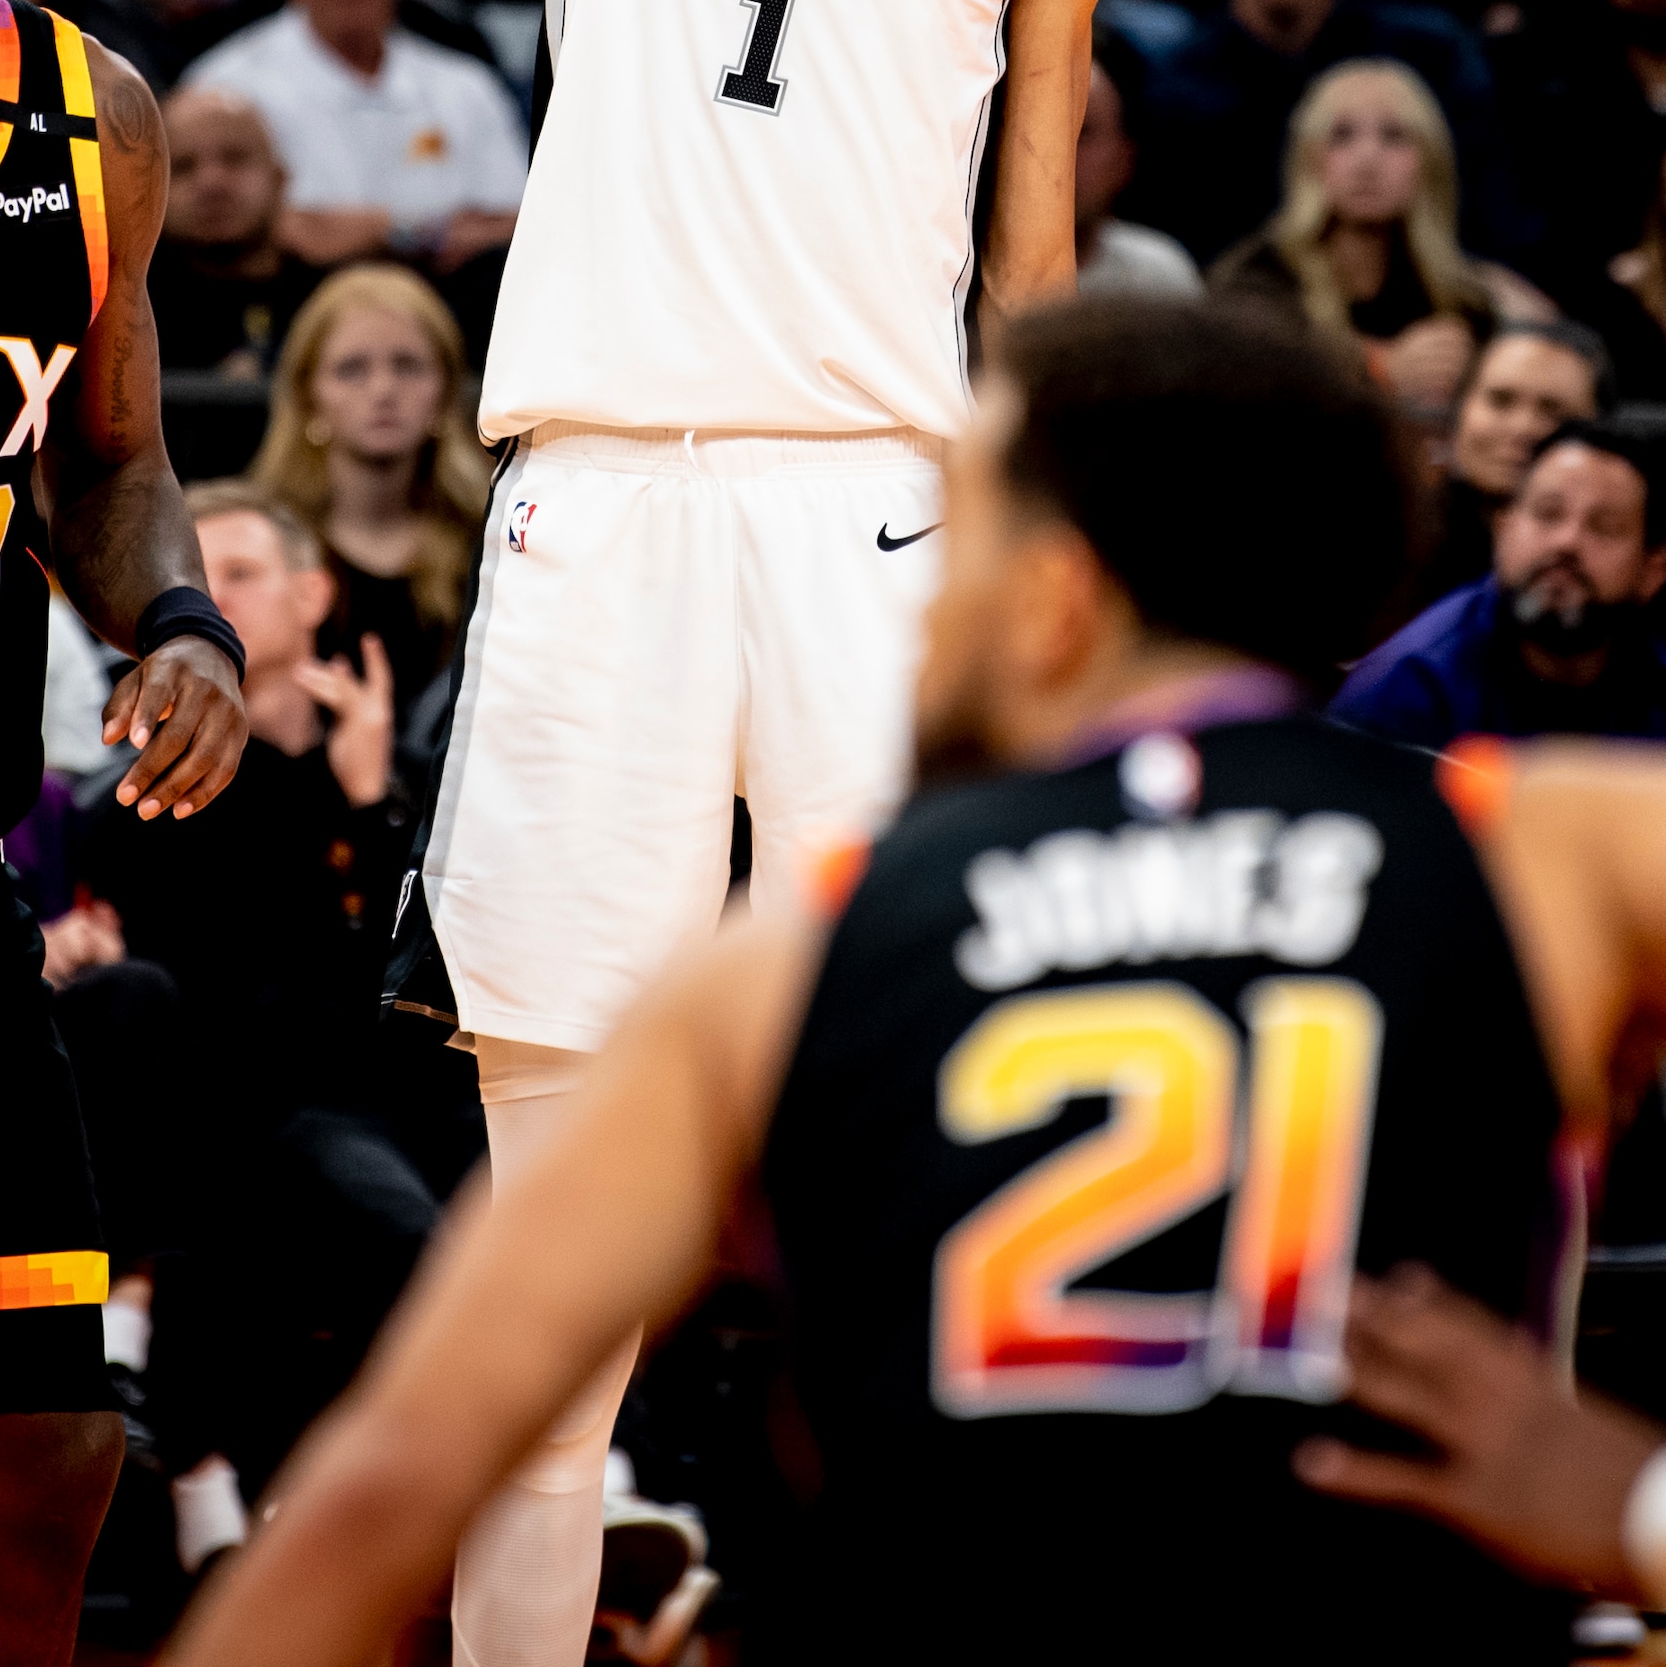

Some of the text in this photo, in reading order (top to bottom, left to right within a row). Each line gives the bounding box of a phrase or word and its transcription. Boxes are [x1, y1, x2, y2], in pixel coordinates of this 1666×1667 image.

[29, 112, 47, 132] AL
[954, 810, 1383, 991] JONES
[929, 974, 1385, 1421] 21
